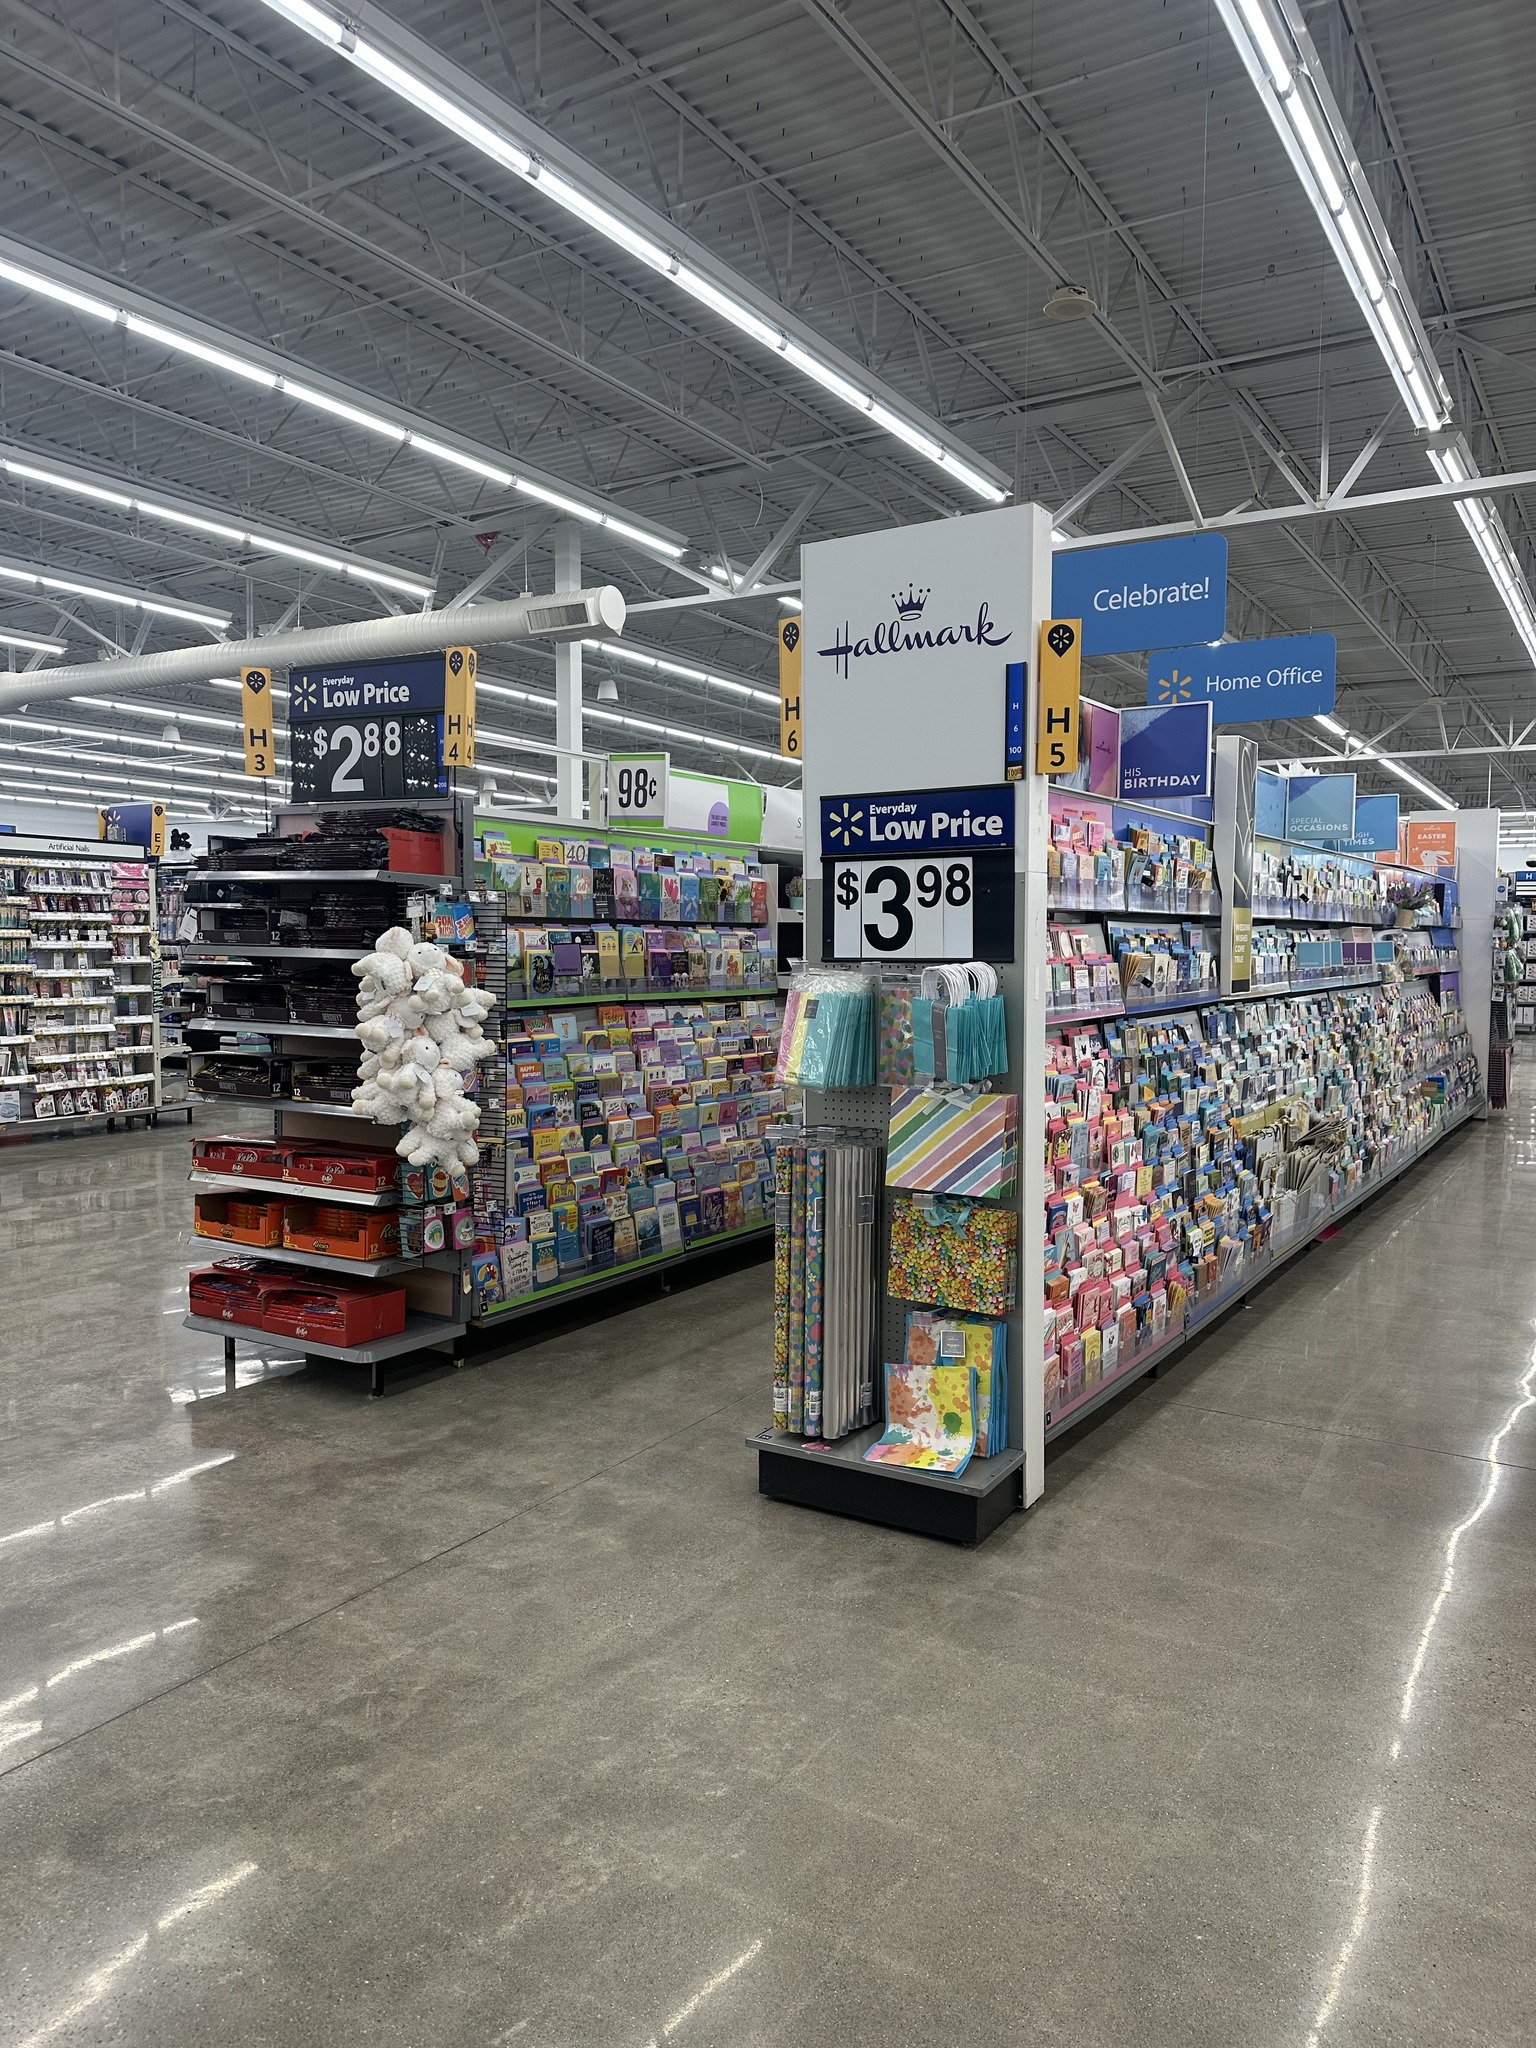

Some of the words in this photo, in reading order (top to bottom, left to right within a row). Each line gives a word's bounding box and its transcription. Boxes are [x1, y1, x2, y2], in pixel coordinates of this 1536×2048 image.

[1093, 576, 1210, 612] Celebrate!
[817, 602, 1013, 679] Hallmark
[322, 675, 354, 687] Everyday
[1206, 674, 1261, 693] Home
[1266, 666, 1323, 687] Office
[322, 686, 360, 708] Low
[363, 680, 410, 705] Price
[785, 696, 800, 721] H
[1013, 702, 1019, 710] H
[449, 714, 461, 735] H
[1047, 707, 1070, 734] H
[467, 715, 473, 738] H
[1013, 724, 1019, 732] 6
[250, 728, 267, 747] H
[787, 730, 798, 752] 6
[449, 743, 459, 761] 4
[467, 745, 472, 763] 4
[1009, 746, 1022, 755] 100
[1051, 743, 1066, 767] 5
[254, 754, 266, 771] 3
[1124, 767, 1142, 777] HIS
[1124, 774, 1201, 789] BIRTHDAY
[869, 802, 917, 816] Everyday
[869, 816, 926, 842] Low
[931, 809, 1004, 839] Price
[1290, 817, 1323, 825] SPECIAL
[1290, 823, 1349, 832] OCCASIONS
[154, 833, 161, 842] E
[1343, 837, 1375, 846] TIMES
[48, 843, 74, 851] Artificial
[75, 844, 90, 852] Nails
[154, 845, 161, 854] 7
[566, 844, 586, 862] 40
[1525, 872, 1533, 880] H
[270, 931, 281, 941] 12
[207, 1005, 213, 1013] 12
[290, 1011, 297, 1019] 12
[519, 1065, 536, 1073] HAPPY
[188, 1079, 194, 1087] 12
[272, 1083, 281, 1092] 12
[293, 1087, 300, 1096] 12
[505, 1113, 524, 1126] SON
[192, 1159, 199, 1167] 12
[282, 1168, 290, 1176] 12
[377, 1176, 386, 1186] 12
[195, 1221, 201, 1229] 12
[270, 1230, 279, 1240] 12
[283, 1235, 290, 1243] 12
[370, 1243, 379, 1253] 12
